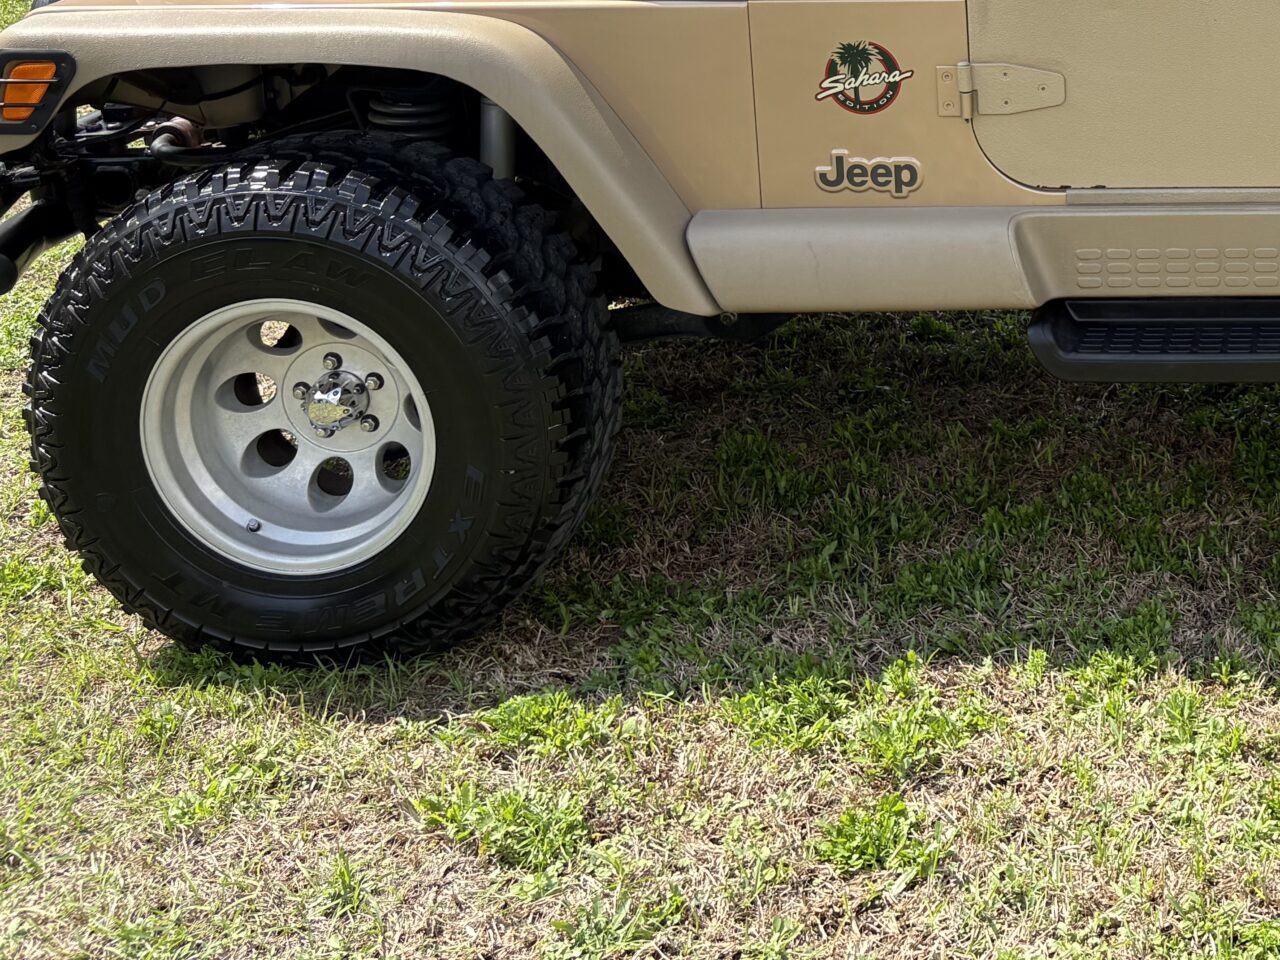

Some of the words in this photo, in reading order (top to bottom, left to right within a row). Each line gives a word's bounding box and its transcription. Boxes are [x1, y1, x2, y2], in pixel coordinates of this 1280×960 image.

[816, 67, 913, 100] Sahara
[838, 90, 893, 110] EDITION
[818, 154, 919, 194] Jeep
[85, 277, 167, 384] MUD
[256, 464, 488, 634] EXTREME
